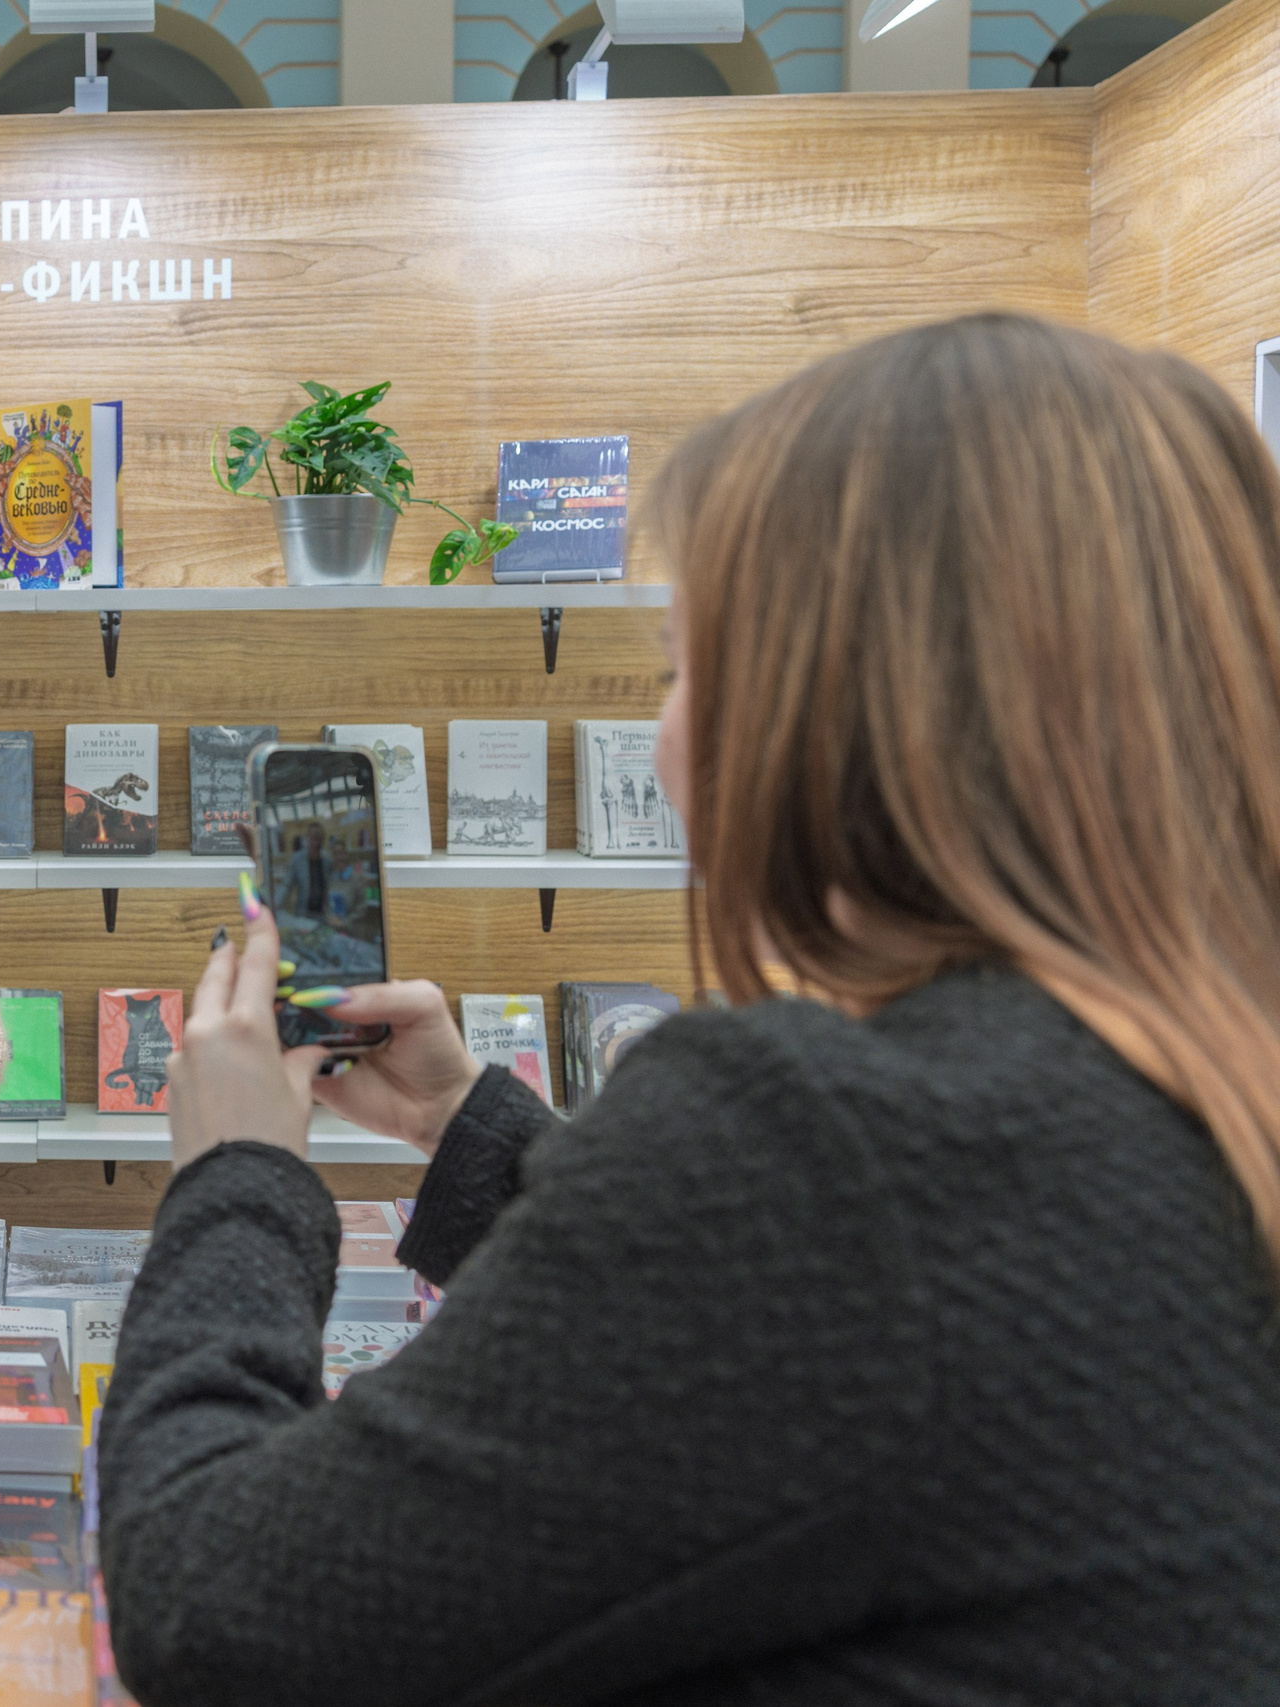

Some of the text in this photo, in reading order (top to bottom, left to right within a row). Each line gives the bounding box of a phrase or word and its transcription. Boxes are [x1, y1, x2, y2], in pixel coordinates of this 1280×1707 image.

[508, 477, 549, 491] КАРЛ
[14, 481, 65, 501] Средне-
[557, 485, 607, 499] САГАН
[12, 500, 68, 518] вековью
[532, 517, 605, 532] КОСМОС
[98, 729, 121, 738] КАК
[82, 740, 137, 748] УМИРАЛИ
[73, 750, 146, 759] ДИНОЗАВРЫ
[138, 1032, 150, 1040] ОТ
[471, 1027, 514, 1040] Дойти
[138, 1040, 179, 1048] САВАННЫ
[472, 1038, 536, 1053] до точки
[138, 1048, 152, 1056] ДО
[138, 1056, 169, 1064] ДИВАН
